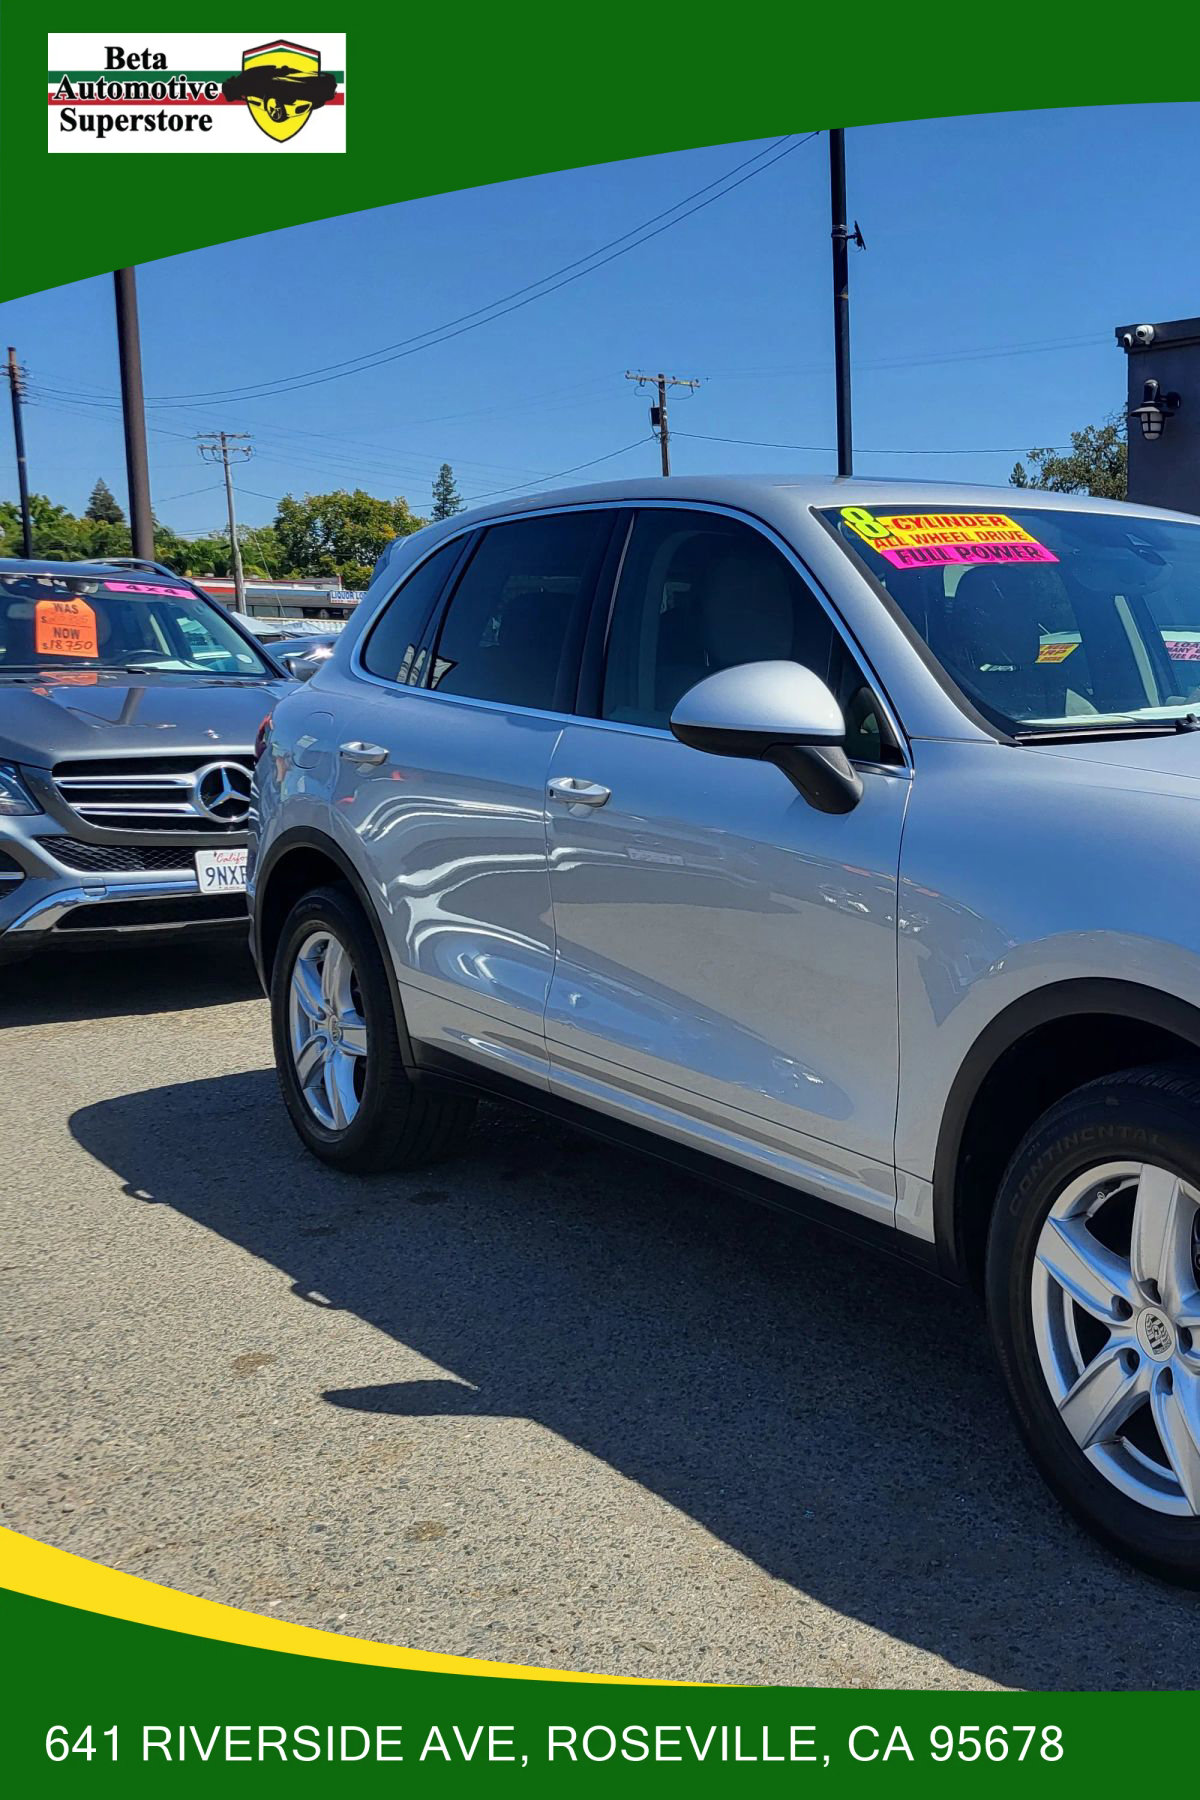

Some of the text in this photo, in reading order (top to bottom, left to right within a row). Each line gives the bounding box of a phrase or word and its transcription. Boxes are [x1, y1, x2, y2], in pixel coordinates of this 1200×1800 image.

[874, 530, 1029, 549] ALL WHEEL DRIVE
[896, 545, 1044, 565] FULL POWER
[54, 603, 79, 615] WAS
[53, 627, 80, 640] NOW
[216, 852, 248, 864] Califo
